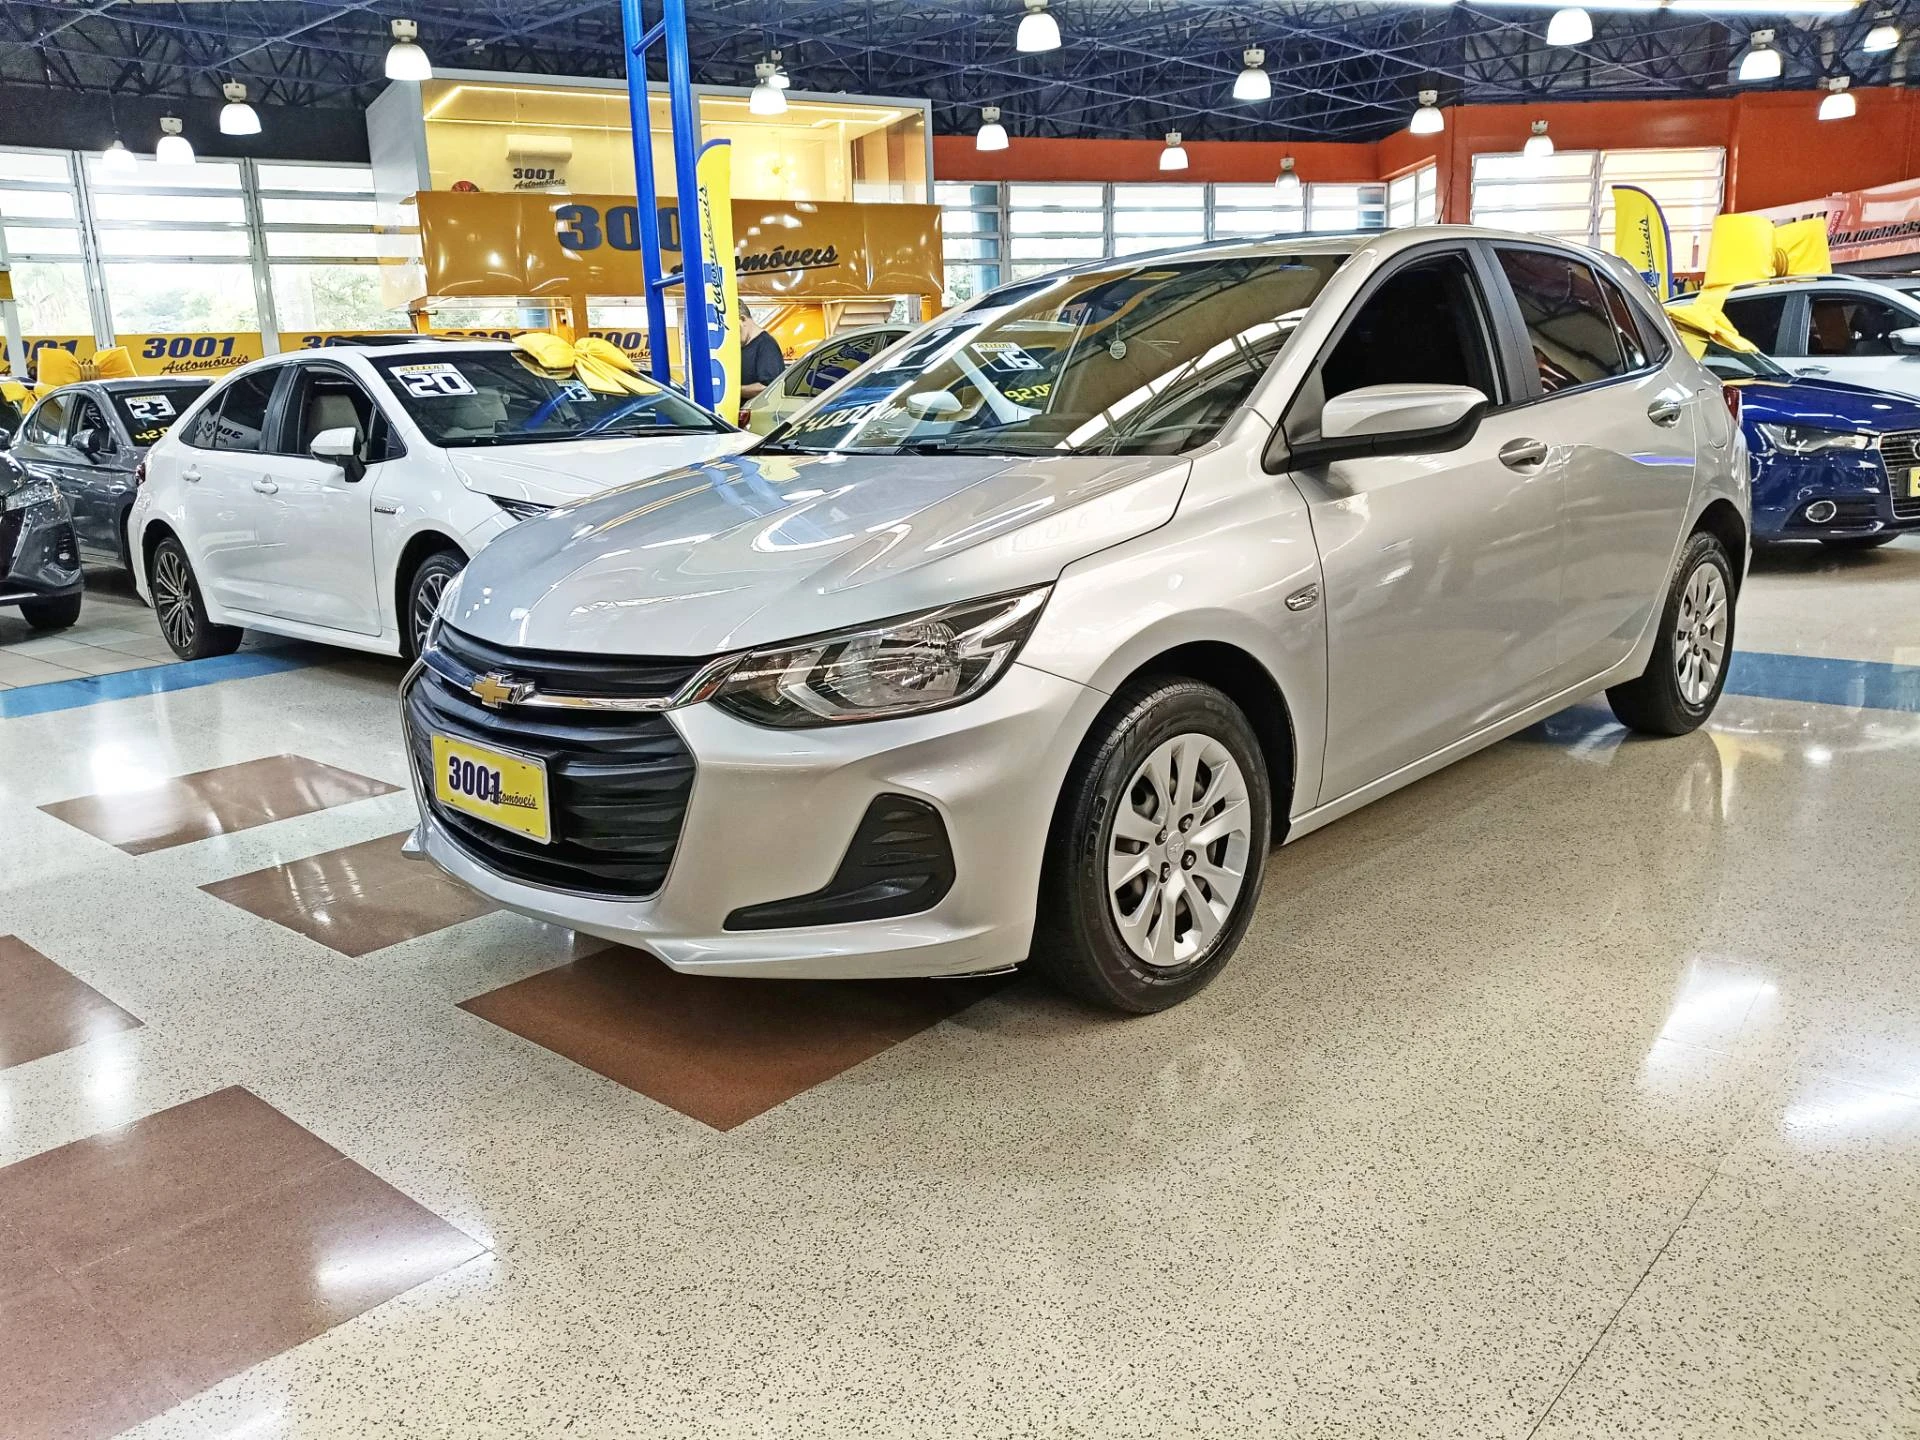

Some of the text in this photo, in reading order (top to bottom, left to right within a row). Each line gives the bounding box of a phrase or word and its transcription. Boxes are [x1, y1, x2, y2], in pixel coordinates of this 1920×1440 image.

[512, 168, 555, 179] 3001
[555, 205, 681, 251] 300
[142, 336, 235, 358] 3001
[160, 354, 249, 375] Automóveis
[996, 351, 1040, 369] 16
[399, 372, 474, 396] 20
[130, 401, 176, 419] 23
[448, 755, 501, 805] 3001
